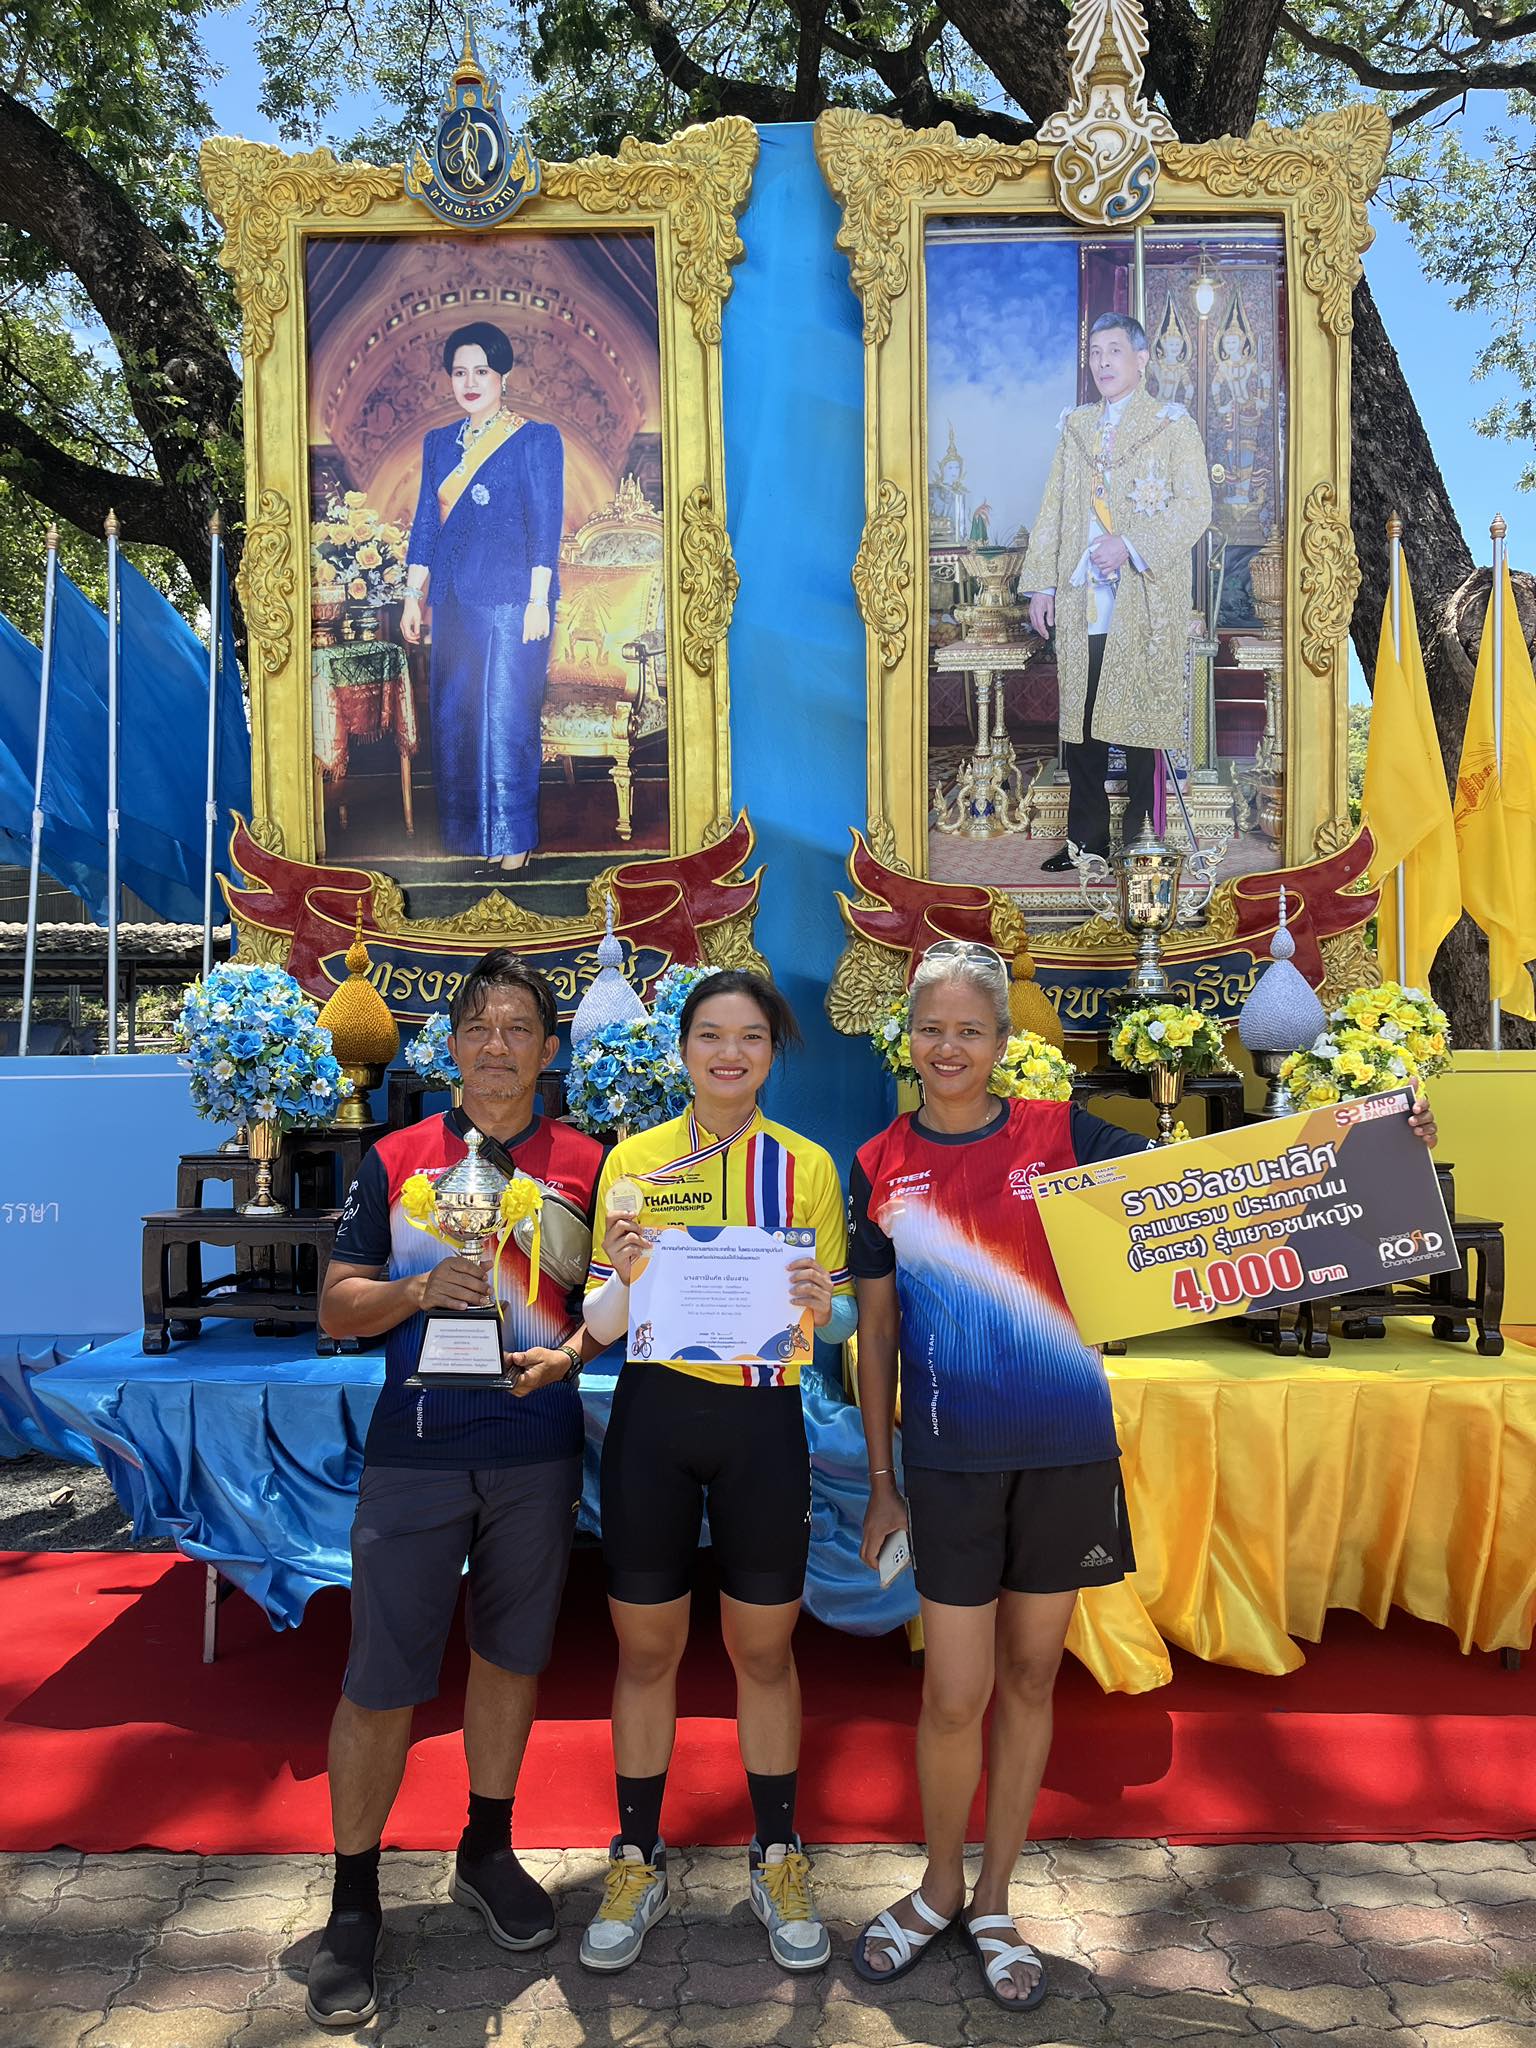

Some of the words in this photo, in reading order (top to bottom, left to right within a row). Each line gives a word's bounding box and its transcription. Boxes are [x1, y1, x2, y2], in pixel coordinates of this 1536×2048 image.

[430, 186, 516, 219] ทรงพระเจริญ
[1364, 1096, 1397, 1111] SINO
[1365, 1103, 1410, 1120] PACIFIC
[886, 1169, 932, 1187] TREK
[1048, 1173, 1097, 1195] TCA
[1121, 1141, 1338, 1217] รางวัลชนะเลิศ
[643, 1192, 713, 1207] THAILAND
[650, 1204, 706, 1213] CHAMPIONSHIPS
[1128, 1203, 1229, 1242] คะแนนรวม
[1233, 1178, 1348, 1217] ประเภทถนน
[1, 1200, 60, 1224] รรษา
[1213, 1202, 1364, 1255] รุ่นเยาวชนหญิง
[1379, 1231, 1411, 1243] Thailand
[1378, 1229, 1443, 1262] ROAD
[1382, 1249, 1447, 1269] Championships
[1171, 1246, 1304, 1313] 4,000
[1308, 1264, 1349, 1285] บาท
[928, 1333, 936, 1357] TEAM
[927, 1358, 938, 1388] FAMILY
[930, 1389, 940, 1437] AMORNBIKE
[1080, 1555, 1114, 1567] adidas
